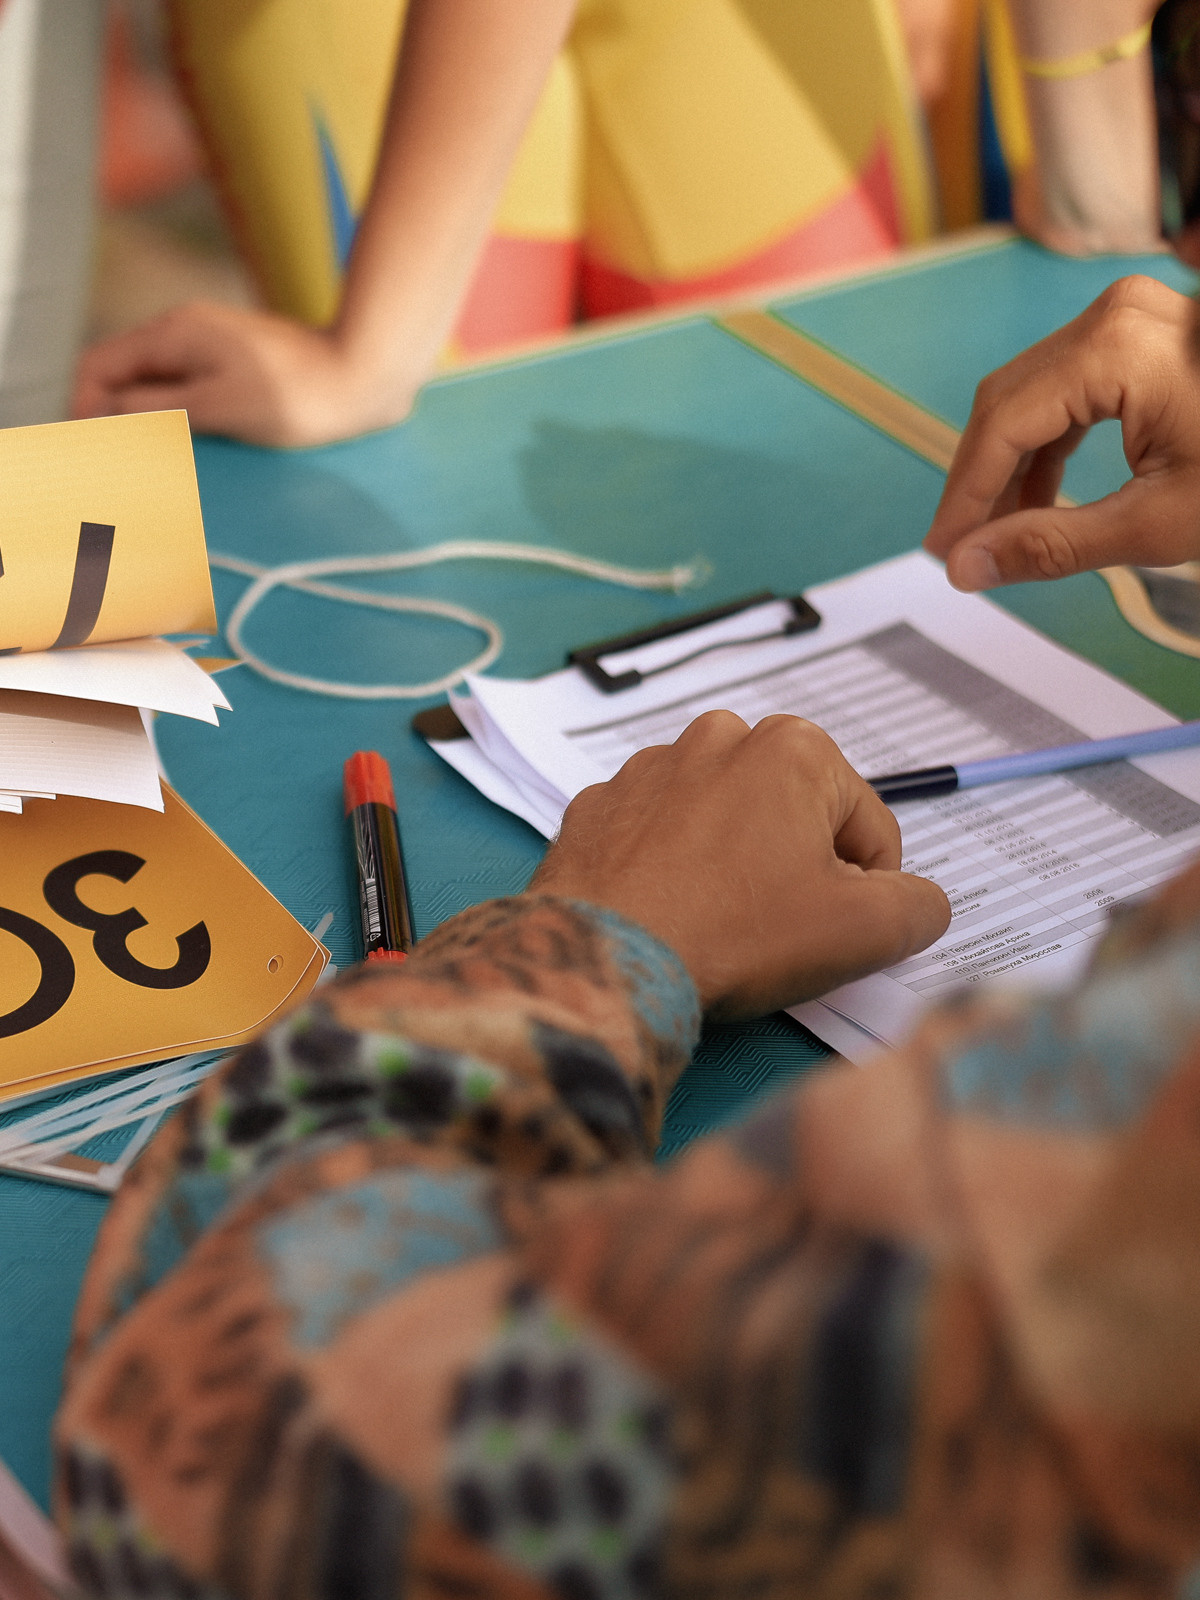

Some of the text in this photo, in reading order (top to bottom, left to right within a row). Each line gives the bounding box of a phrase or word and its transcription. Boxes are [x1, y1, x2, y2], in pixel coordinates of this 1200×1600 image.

[963, 888, 988, 902] Алиса
[931, 952, 947, 961] 104
[981, 925, 1014, 942] Михаил
[943, 959, 959, 969] 108
[960, 941, 1006, 963] Михайлова
[1005, 930, 1031, 946] Арина
[955, 966, 970, 976] 110
[1010, 943, 1032, 955] Иван
[966, 974, 981, 983] 127
[1020, 943, 1063, 962] Мирослав
